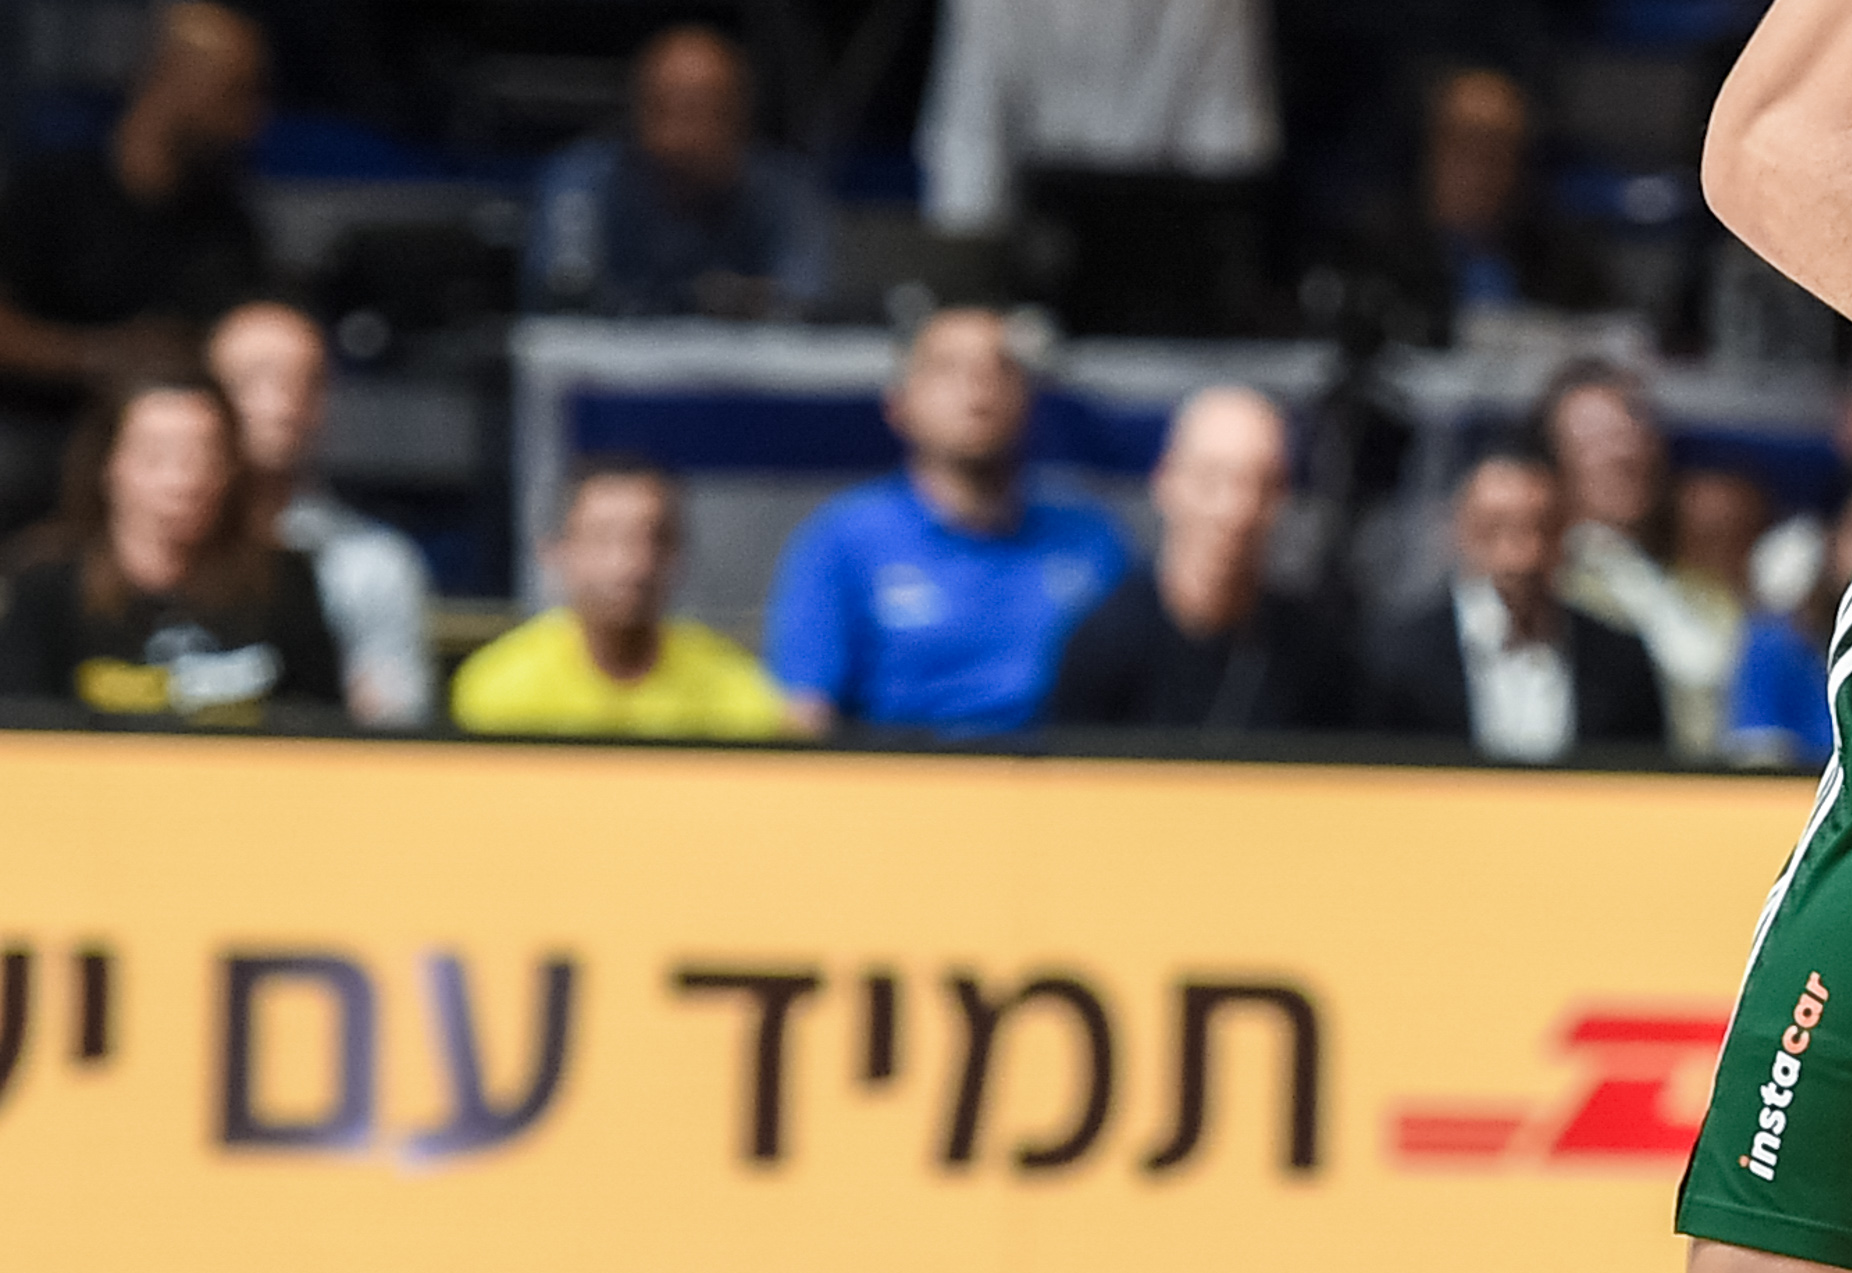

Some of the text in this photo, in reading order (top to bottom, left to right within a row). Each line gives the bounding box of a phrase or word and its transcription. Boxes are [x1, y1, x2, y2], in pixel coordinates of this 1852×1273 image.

[217, 943, 582, 1164] עם
[668, 966, 1332, 1180] תמיד
[1738, 971, 1830, 1182] instacar
